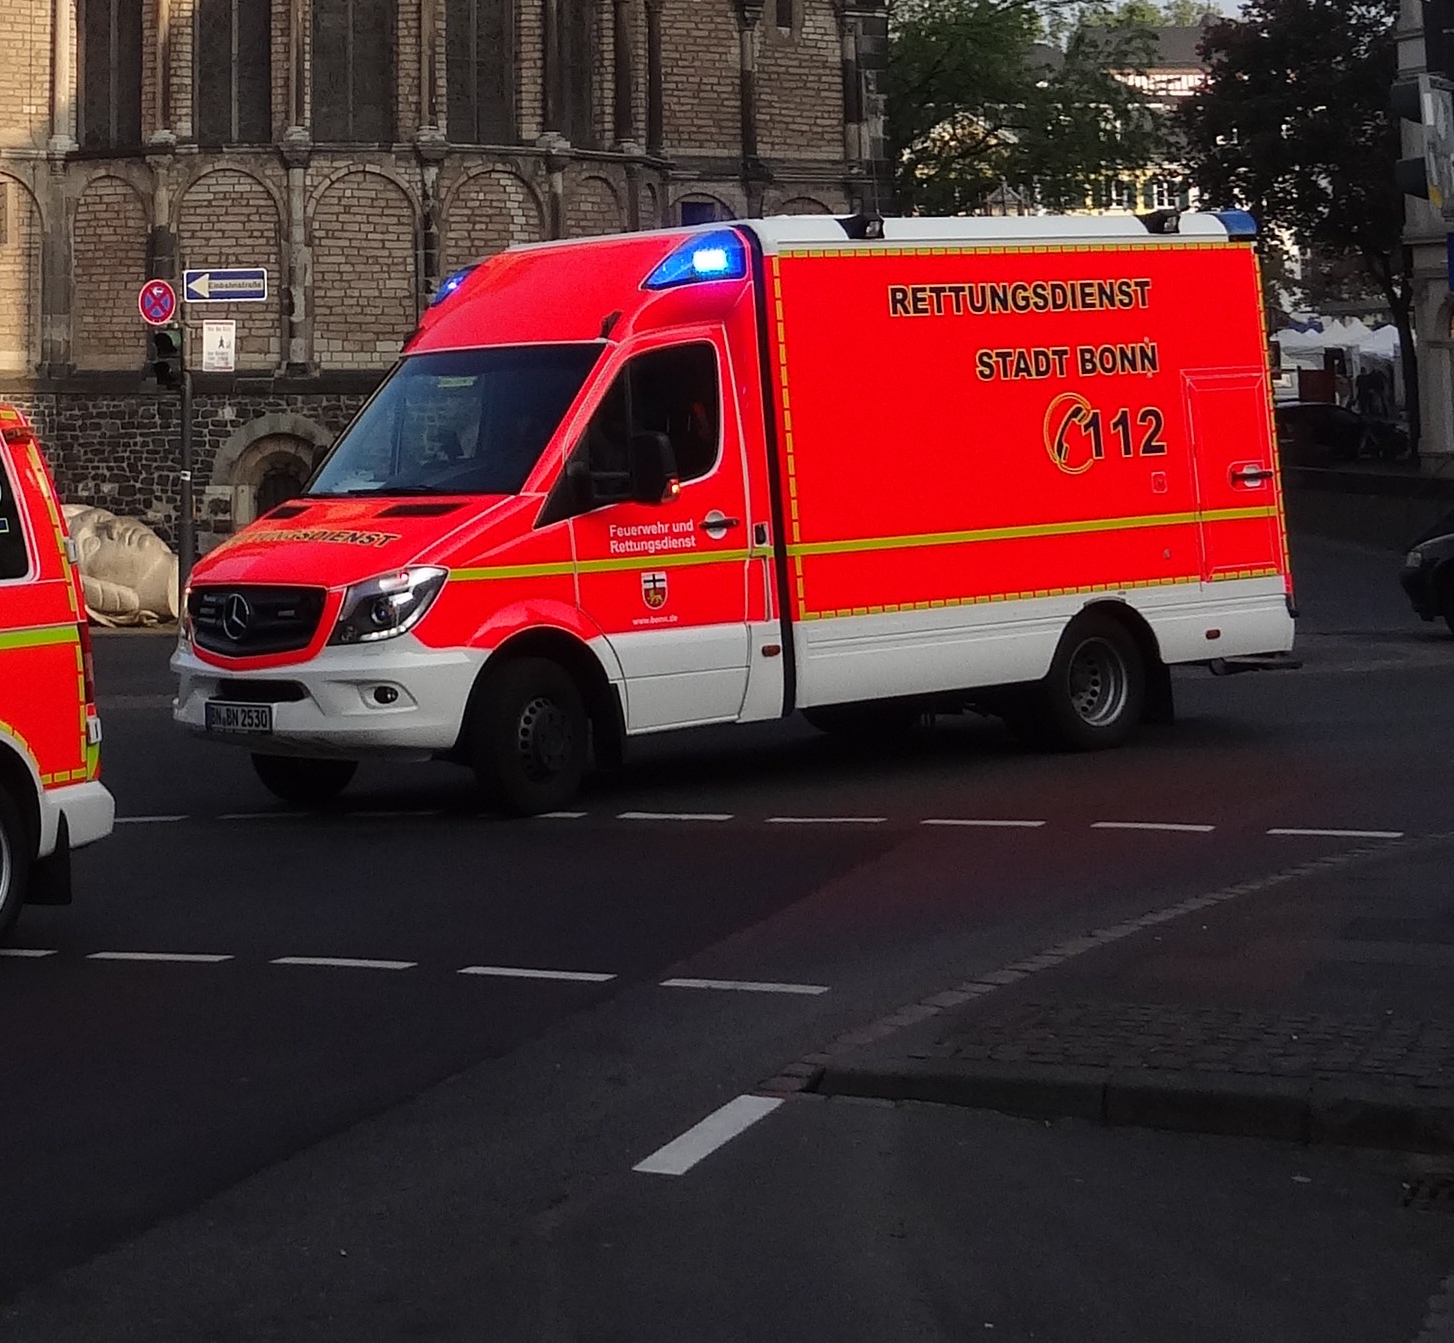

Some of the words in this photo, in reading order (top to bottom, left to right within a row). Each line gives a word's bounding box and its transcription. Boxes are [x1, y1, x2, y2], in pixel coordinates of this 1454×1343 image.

[888, 278, 1151, 317] RETTUNGSDIENST
[975, 346, 1070, 381] STADT
[1077, 342, 1160, 377] BONN
[1081, 407, 1167, 460] 112
[609, 521, 669, 537] Feuerwehr
[672, 519, 694, 533] und
[610, 535, 696, 554] Rettungsdienst
[241, 708, 267, 728] 2530
